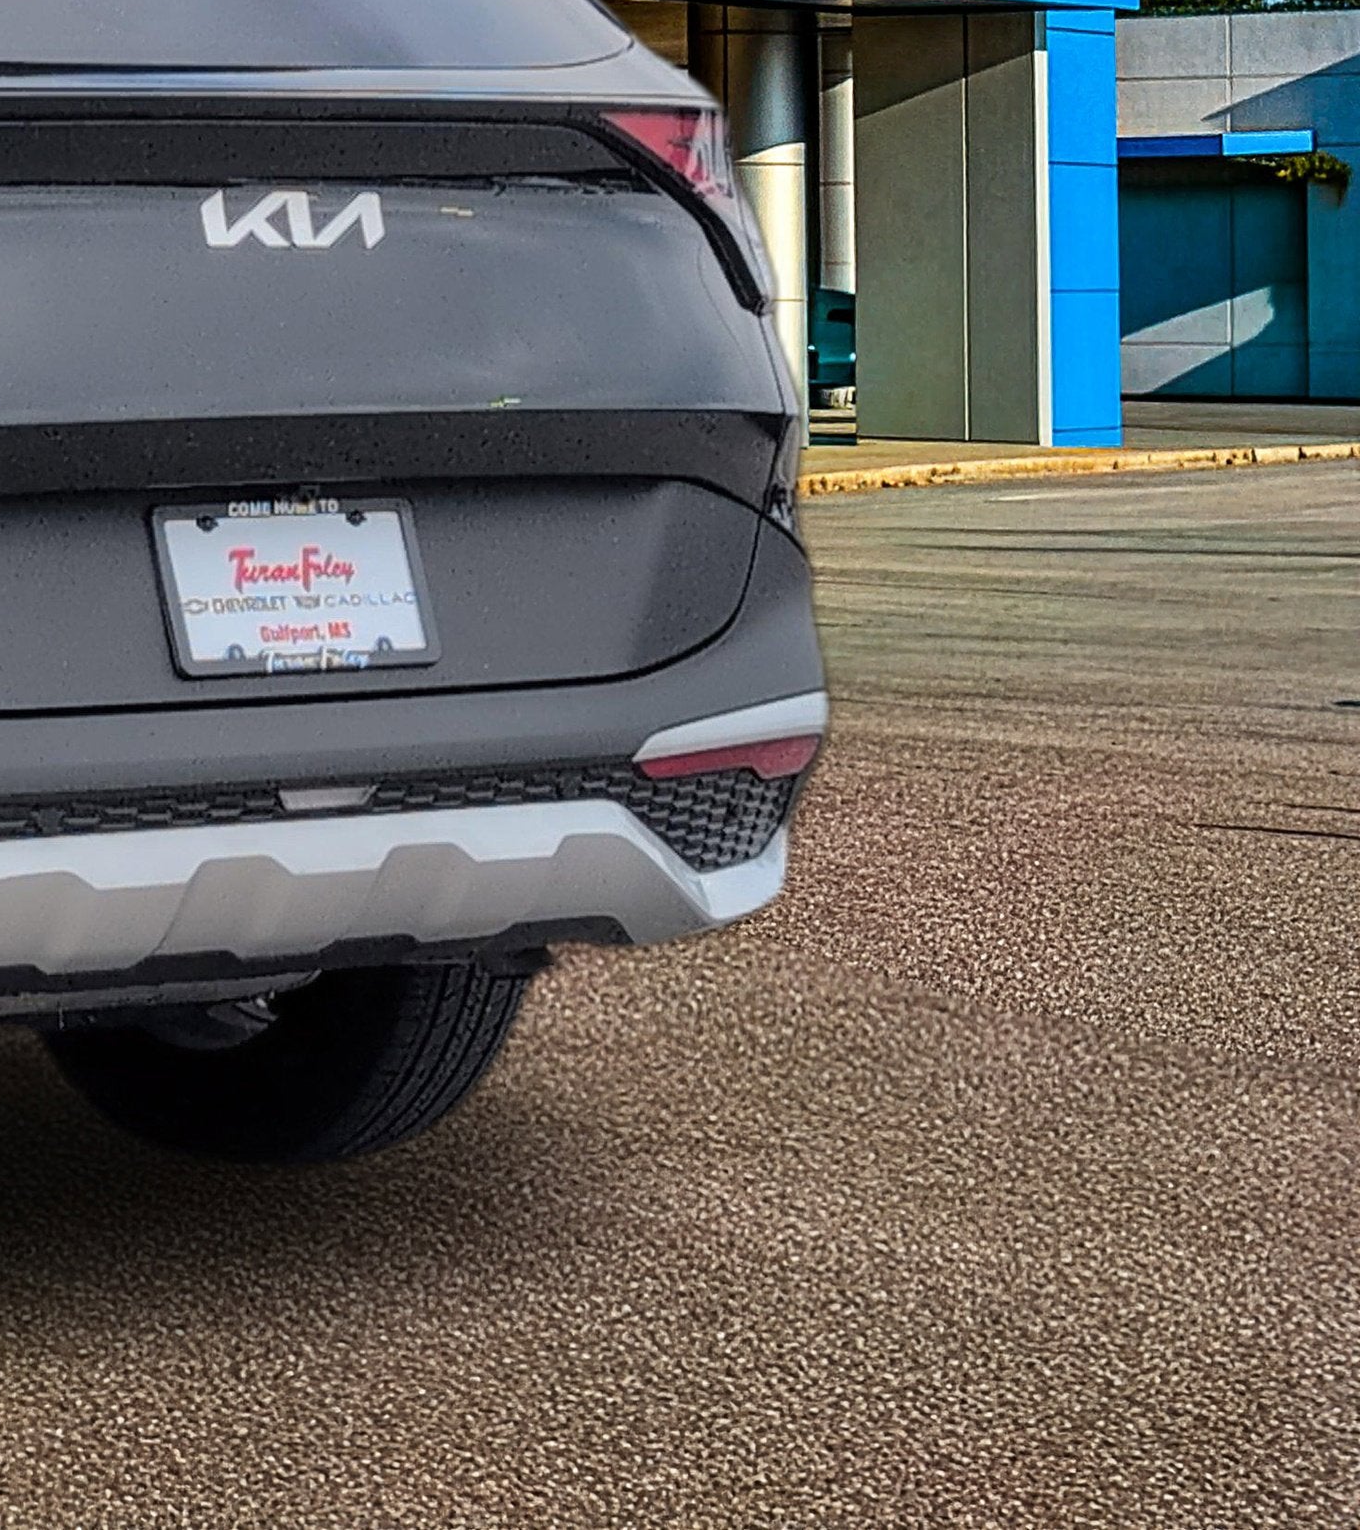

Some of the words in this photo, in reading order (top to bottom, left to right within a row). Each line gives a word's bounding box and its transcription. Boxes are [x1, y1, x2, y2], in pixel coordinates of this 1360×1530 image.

[200, 188, 386, 250] KIA
[228, 500, 271, 517] COME
[318, 497, 339, 513] TO
[211, 596, 287, 614] CHEVROLET
[323, 591, 416, 608] CADILLAC
[327, 620, 352, 639] MS
